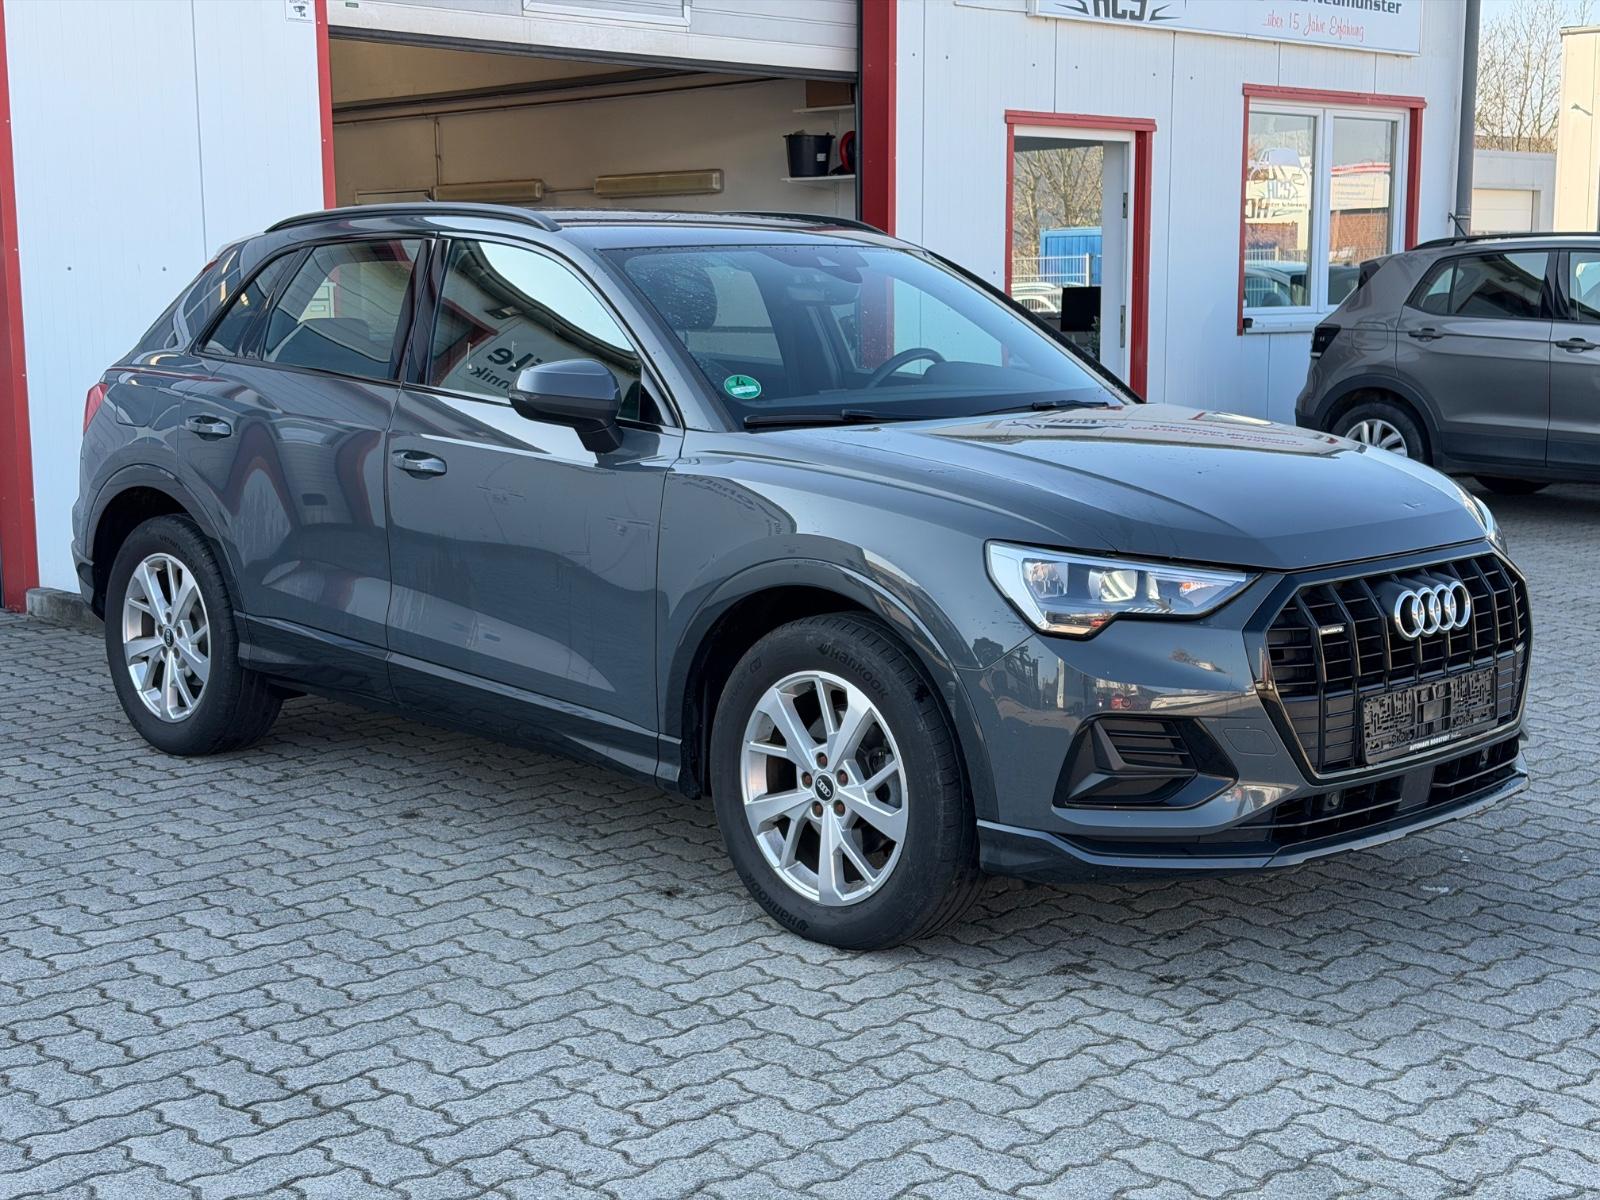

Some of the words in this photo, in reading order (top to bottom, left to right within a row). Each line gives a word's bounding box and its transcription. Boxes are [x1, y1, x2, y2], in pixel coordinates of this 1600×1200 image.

[1289, 12, 1300, 30] 15
[1303, 13, 1326, 36] Jahre
[1329, 15, 1364, 42] Erfahrung
